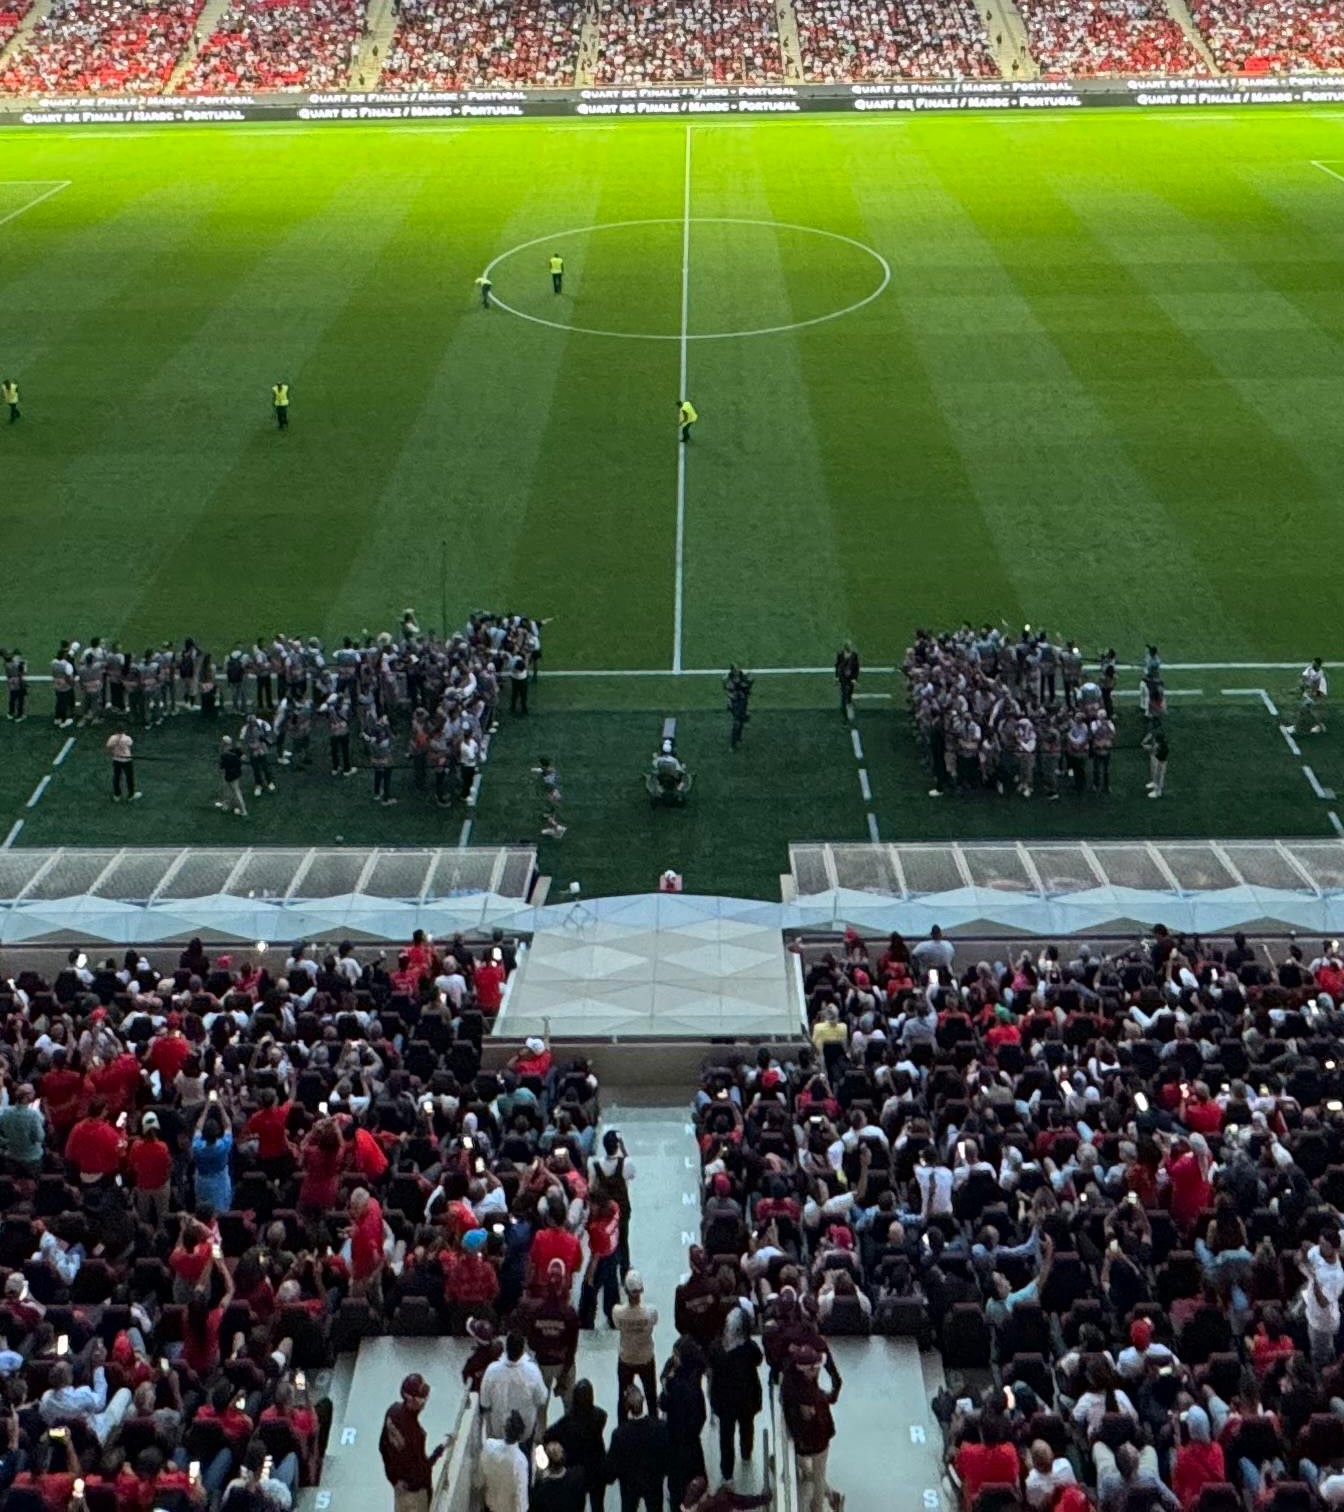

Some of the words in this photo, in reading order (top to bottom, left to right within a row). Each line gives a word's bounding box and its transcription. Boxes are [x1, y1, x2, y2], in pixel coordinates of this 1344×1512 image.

[682, 1192, 696, 1205] M
[681, 1231, 695, 1244] N
[340, 1428, 356, 1445] R
[909, 1425, 926, 1443] R
[315, 1491, 331, 1509] S
[923, 1489, 938, 1508] S
